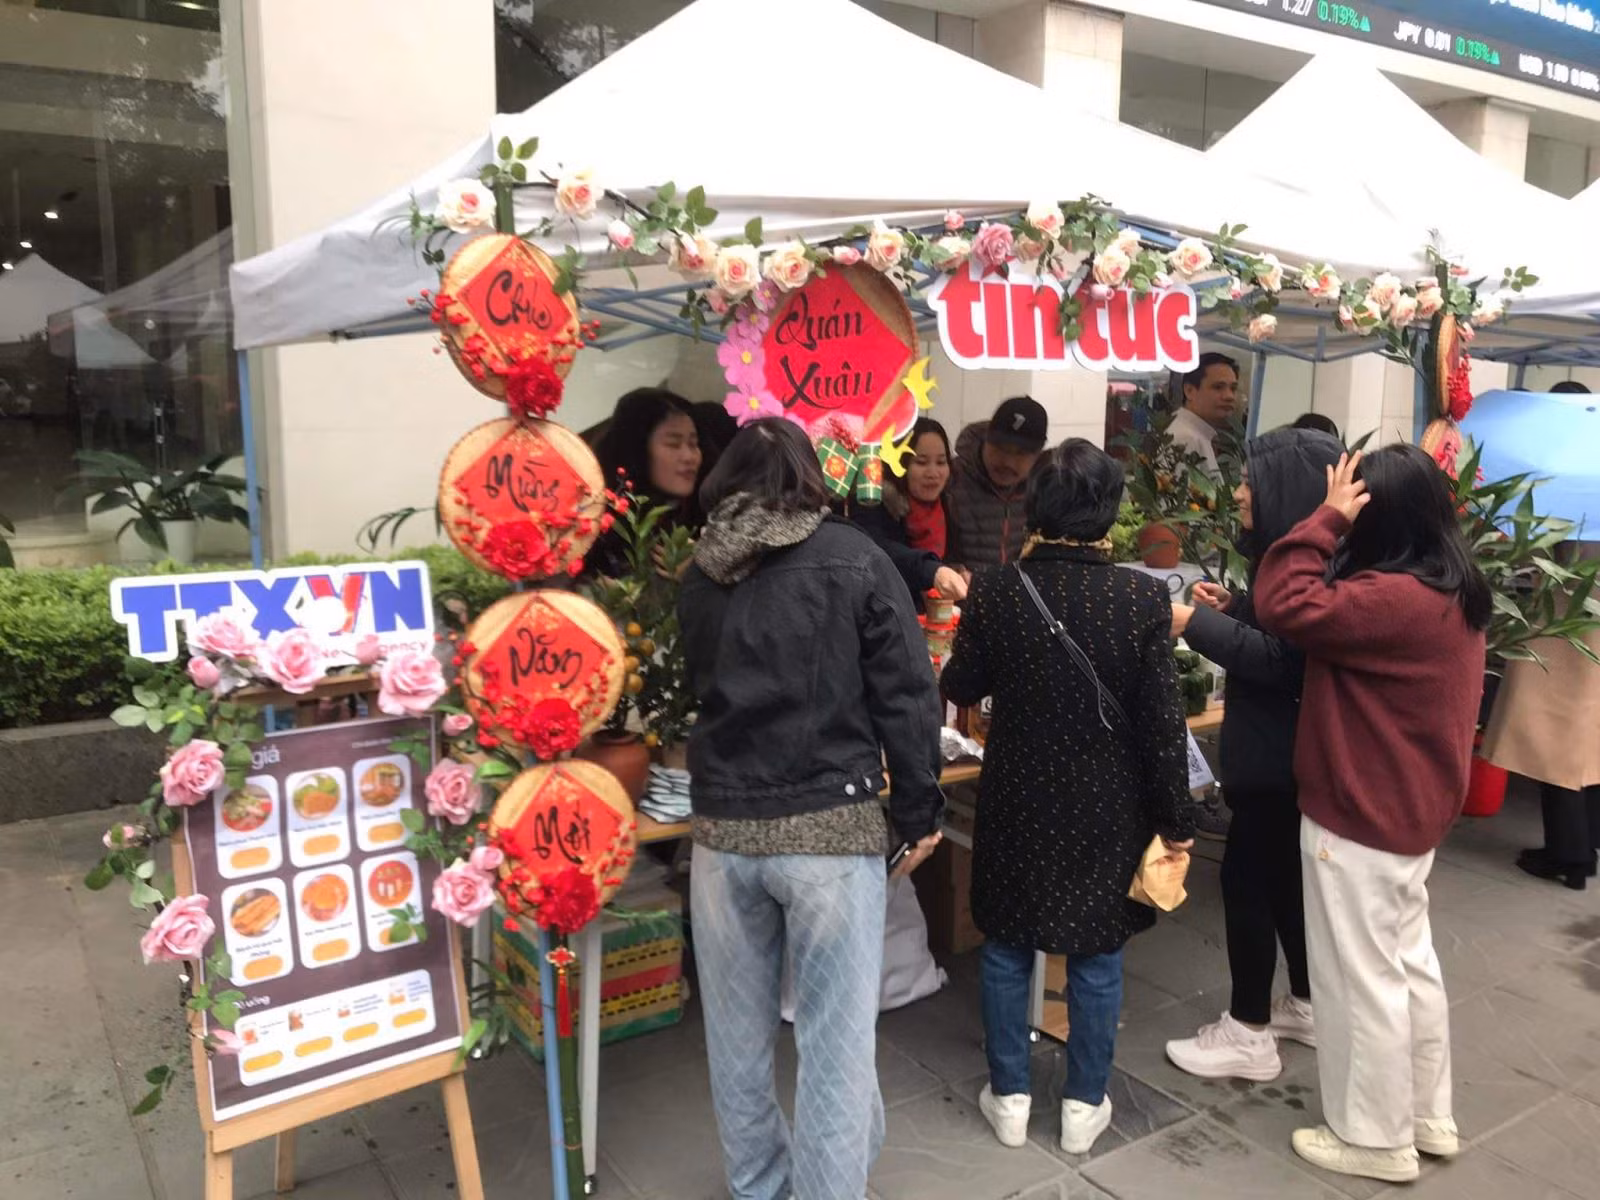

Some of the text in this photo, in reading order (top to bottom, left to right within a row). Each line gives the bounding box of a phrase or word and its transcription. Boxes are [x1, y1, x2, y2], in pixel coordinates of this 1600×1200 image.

[1394, 21, 1422, 44] JPY
[775, 292, 863, 350] Quán
[939, 257, 1065, 360] tin
[780, 355, 873, 409] Xuân
